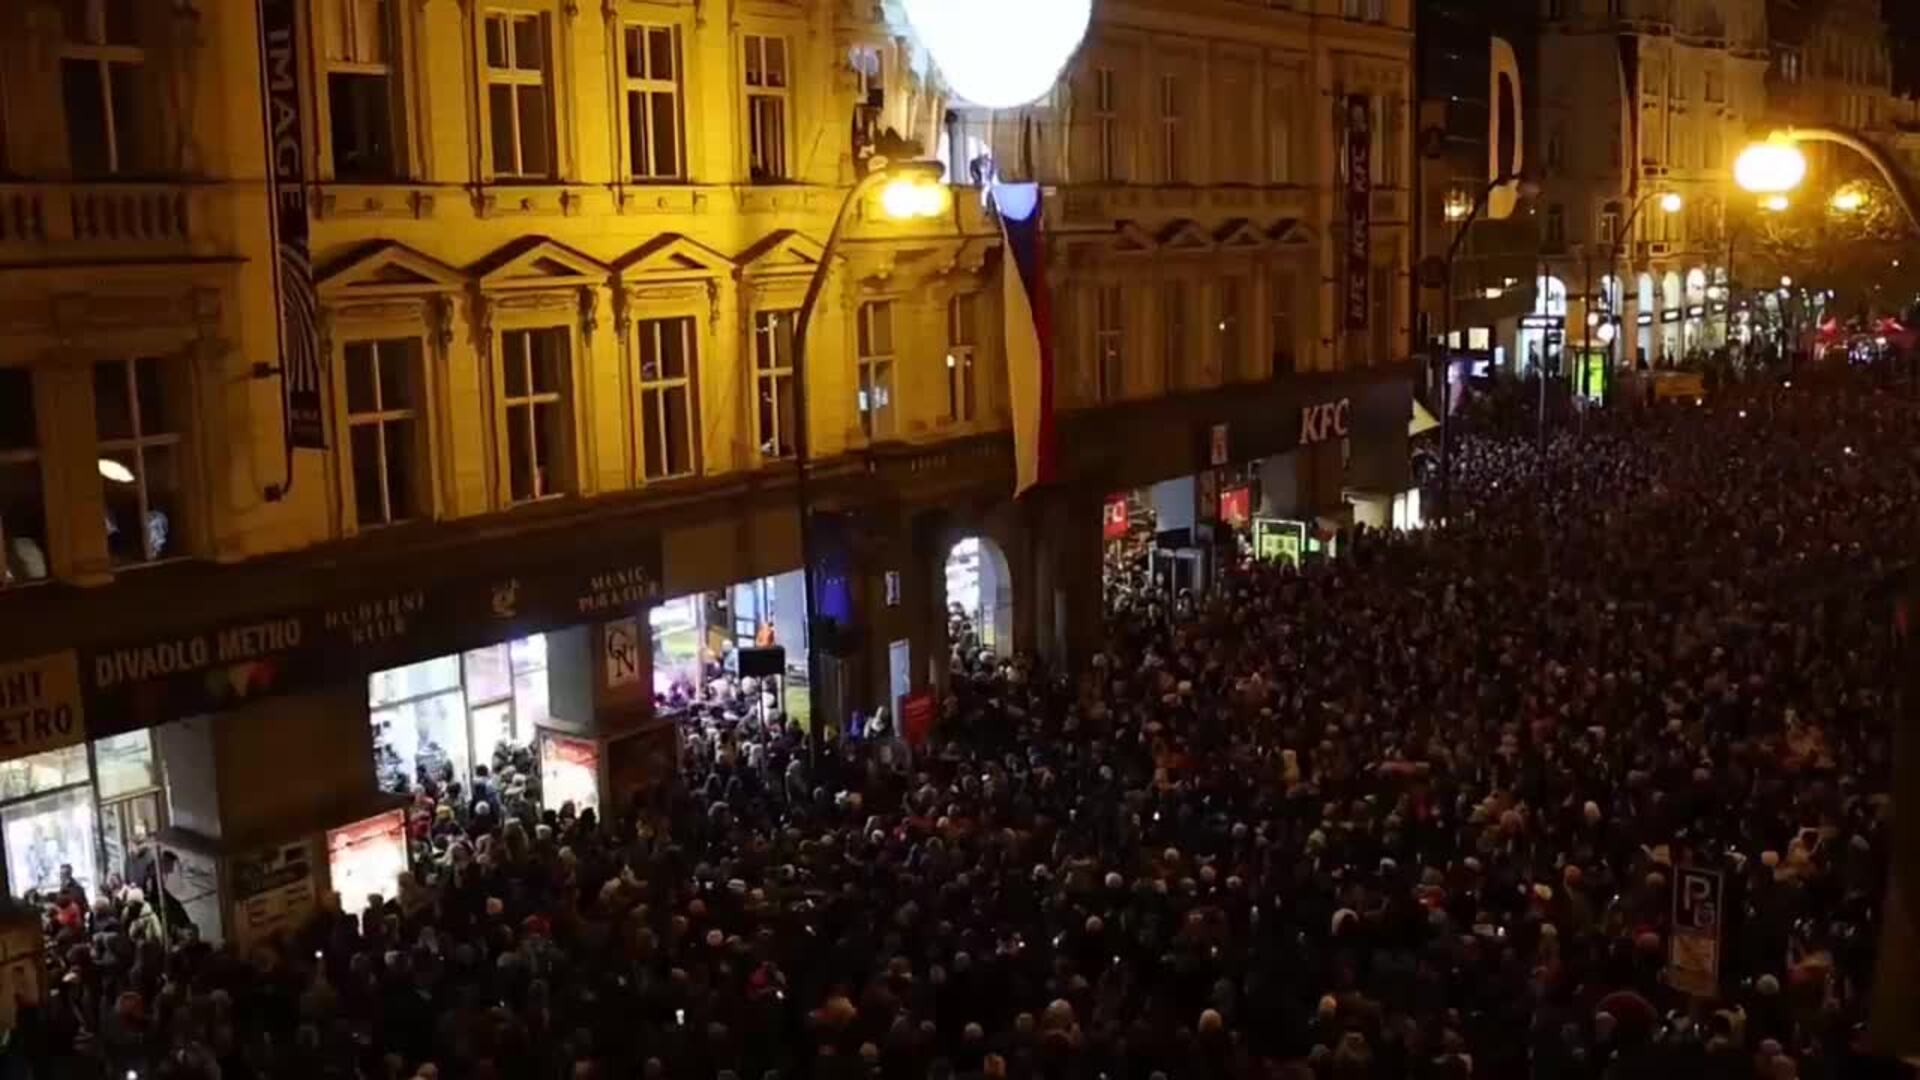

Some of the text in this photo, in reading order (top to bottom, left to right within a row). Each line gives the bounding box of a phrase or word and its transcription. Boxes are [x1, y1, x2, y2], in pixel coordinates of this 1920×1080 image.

[268, 28, 303, 212] IMAGE
[1300, 398, 1350, 445] KFC
[97, 617, 301, 688] DIVADLO METRO
[1683, 874, 1711, 911] P
